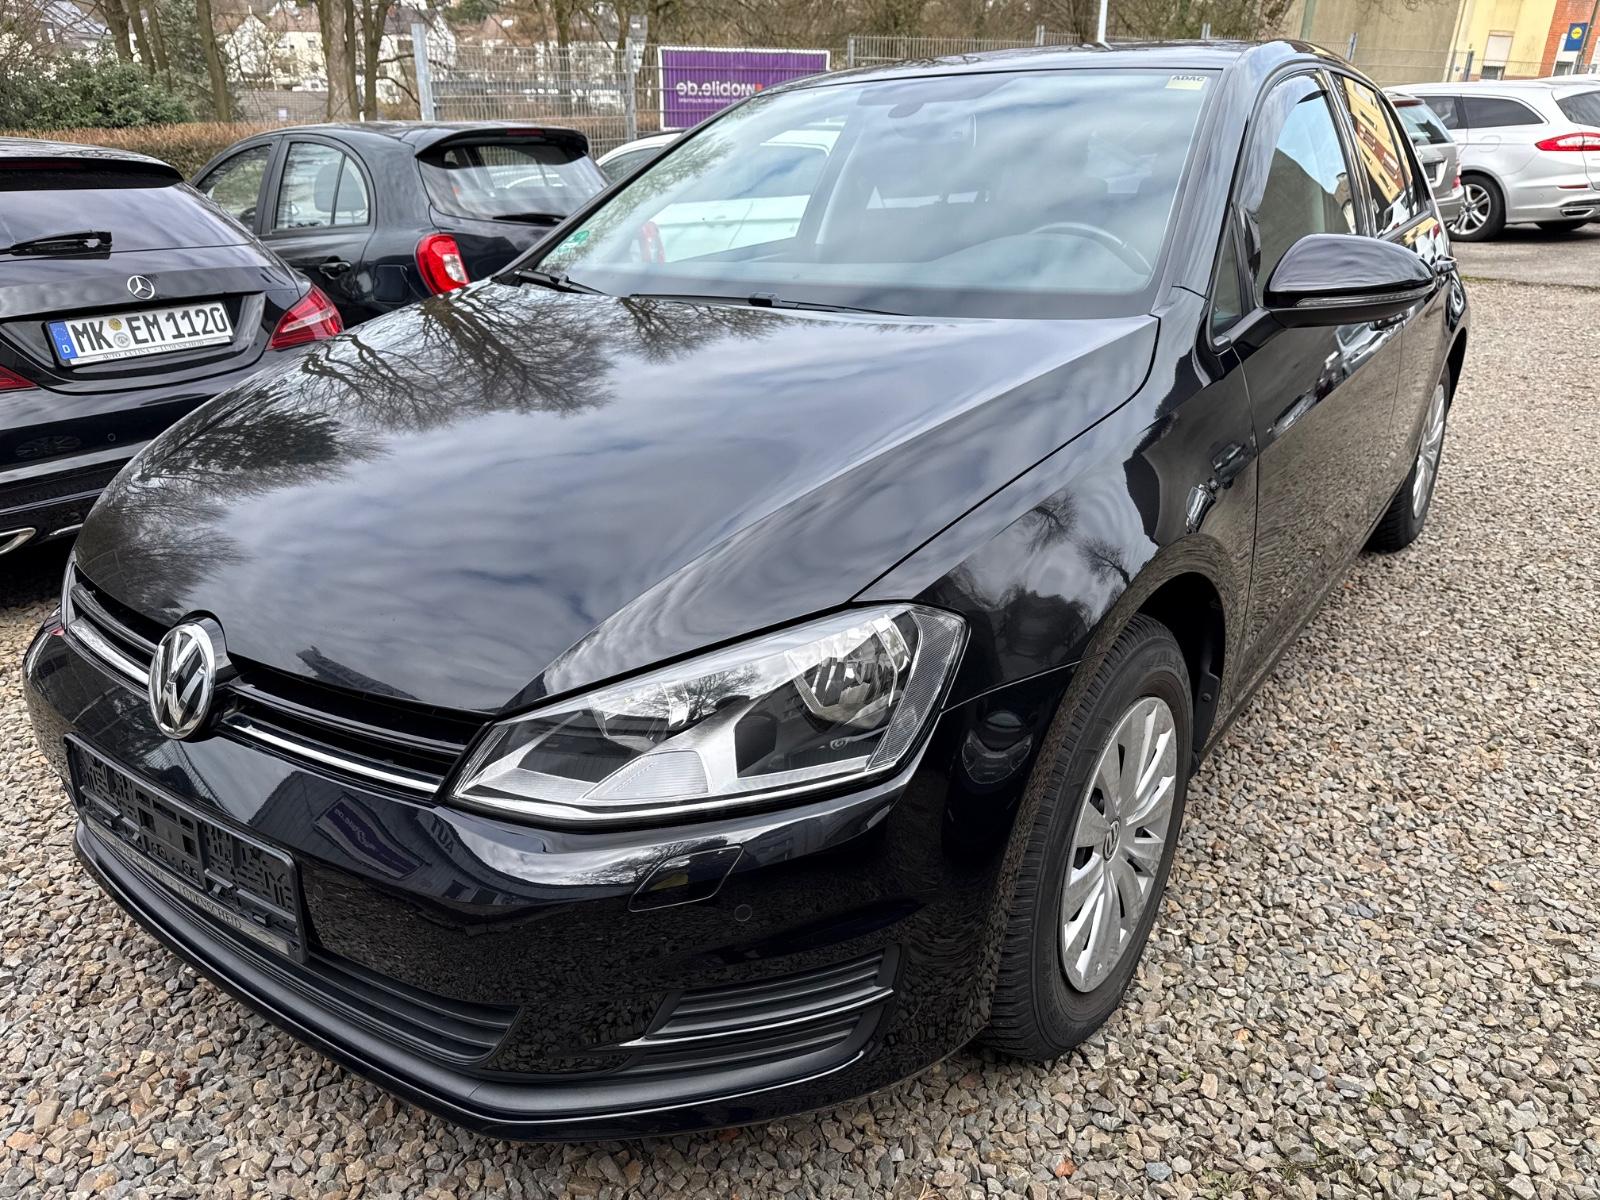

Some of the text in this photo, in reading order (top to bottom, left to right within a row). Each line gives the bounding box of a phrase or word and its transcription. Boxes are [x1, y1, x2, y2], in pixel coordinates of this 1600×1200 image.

[70, 306, 228, 353] MK EM 1120
[62, 344, 71, 354] D
